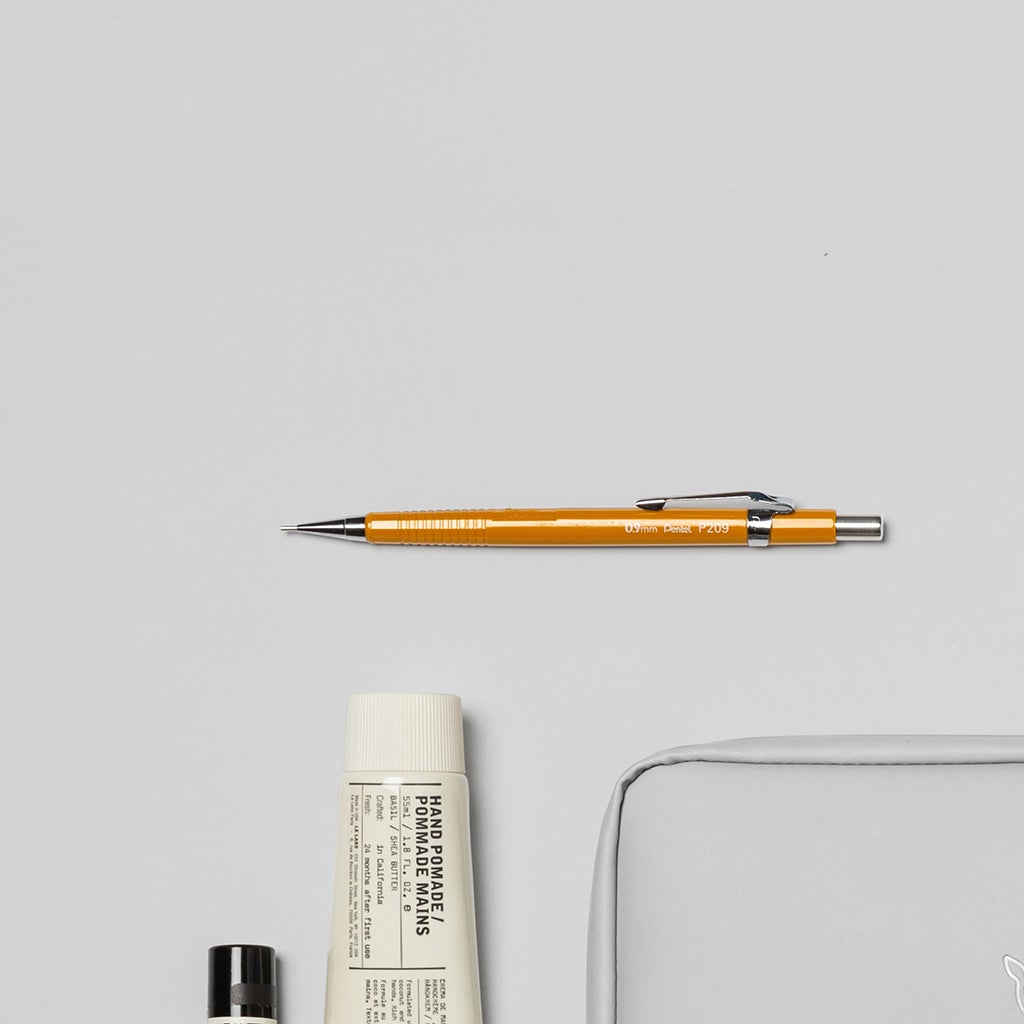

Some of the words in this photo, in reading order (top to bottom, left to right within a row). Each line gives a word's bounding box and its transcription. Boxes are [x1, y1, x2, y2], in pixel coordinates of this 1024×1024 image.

[625, 523, 657, 533] 0.9mm
[664, 524, 692, 533] Pentel
[699, 523, 729, 533] P209
[430, 796, 442, 839] HAND
[416, 796, 428, 877] POMMADE
[365, 844, 370, 853] 24
[377, 845, 383, 854] in
[403, 859, 411, 875] FL.
[403, 882, 411, 897] OZ.
[416, 883, 429, 936] MAINS
[381, 1012, 385, 1020] au
